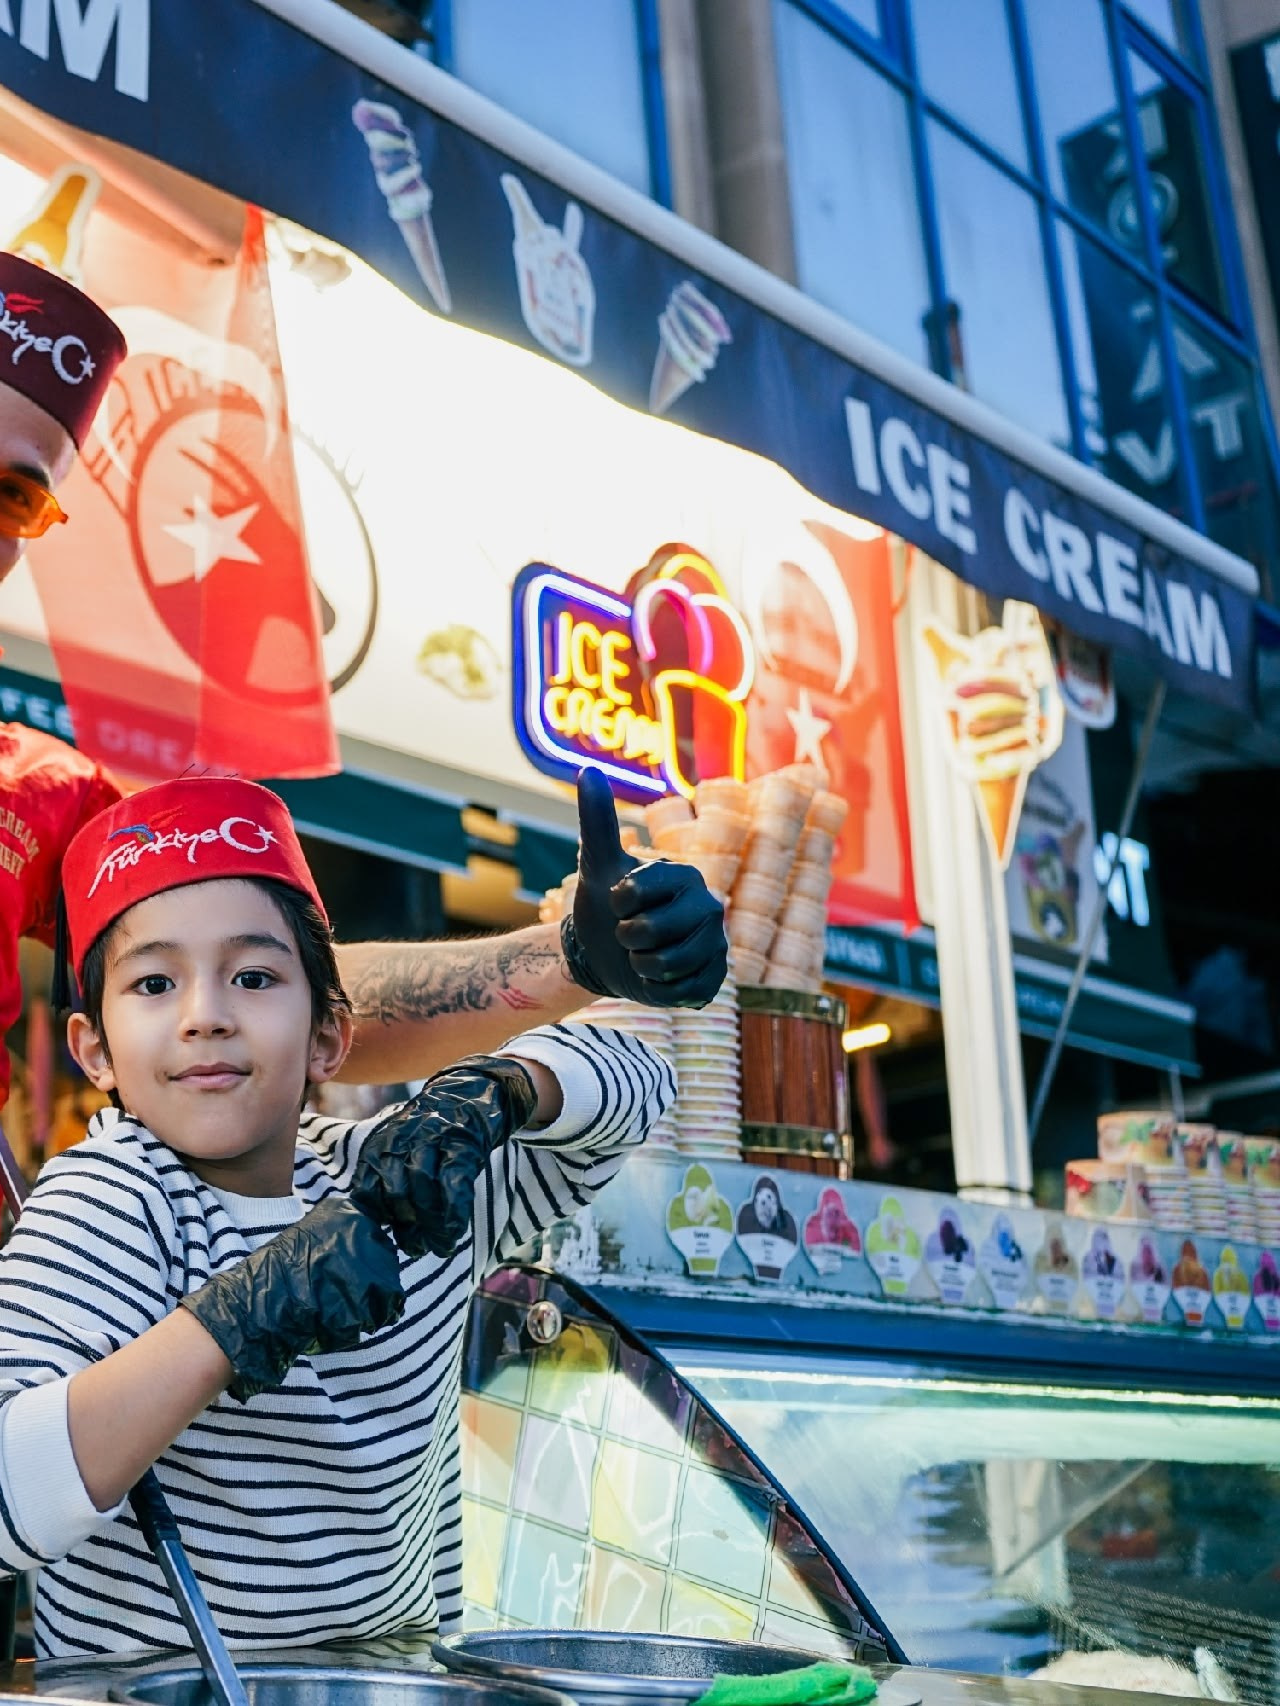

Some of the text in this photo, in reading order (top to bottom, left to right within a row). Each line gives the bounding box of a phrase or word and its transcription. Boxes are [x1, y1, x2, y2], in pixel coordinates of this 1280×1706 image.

[845, 397, 1232, 678] ICE CREAM
[543, 611, 665, 765] ICE CREAM
[87, 827, 220, 899] Türkiye
